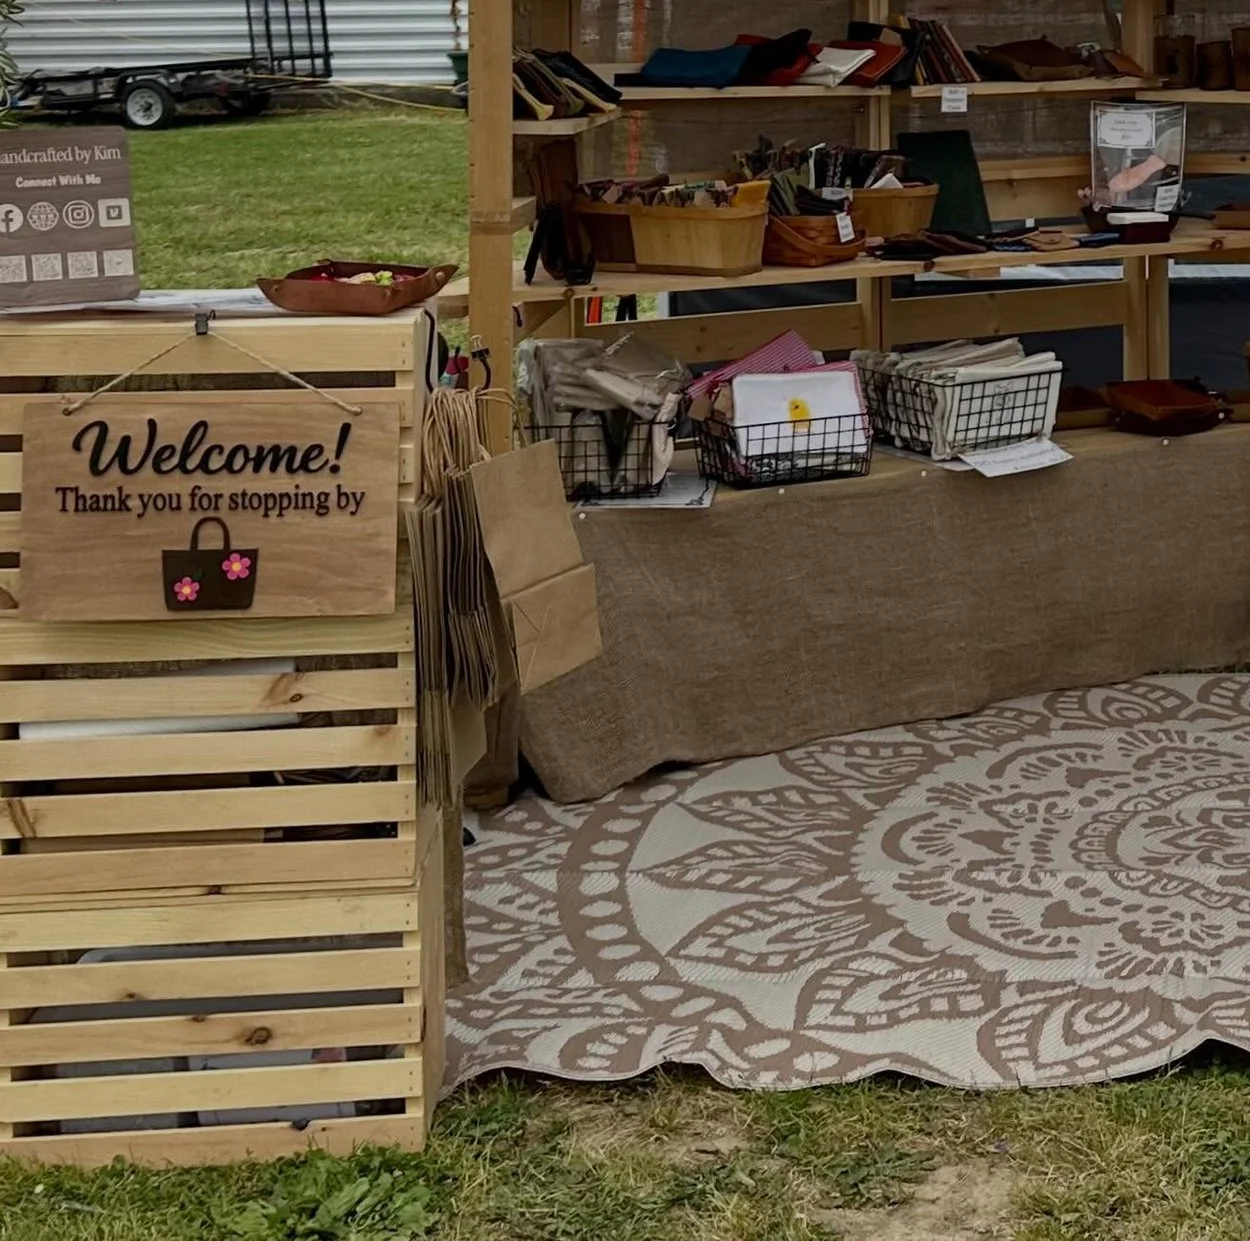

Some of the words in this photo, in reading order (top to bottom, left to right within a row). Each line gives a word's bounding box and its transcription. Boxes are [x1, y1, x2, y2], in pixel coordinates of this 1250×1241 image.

[0, 147, 73, 164] andcrafted
[74, 146, 91, 164] by
[93, 145, 121, 160] Kim
[16, 176, 57, 188] Connect
[58, 174, 84, 186] With
[85, 174, 101, 184] Me
[72, 418, 352, 477] Welcome!
[55, 485, 133, 513] Thank
[136, 492, 182, 518] you
[189, 485, 222, 512] for
[228, 484, 331, 518] stopping
[335, 484, 365, 515] by
